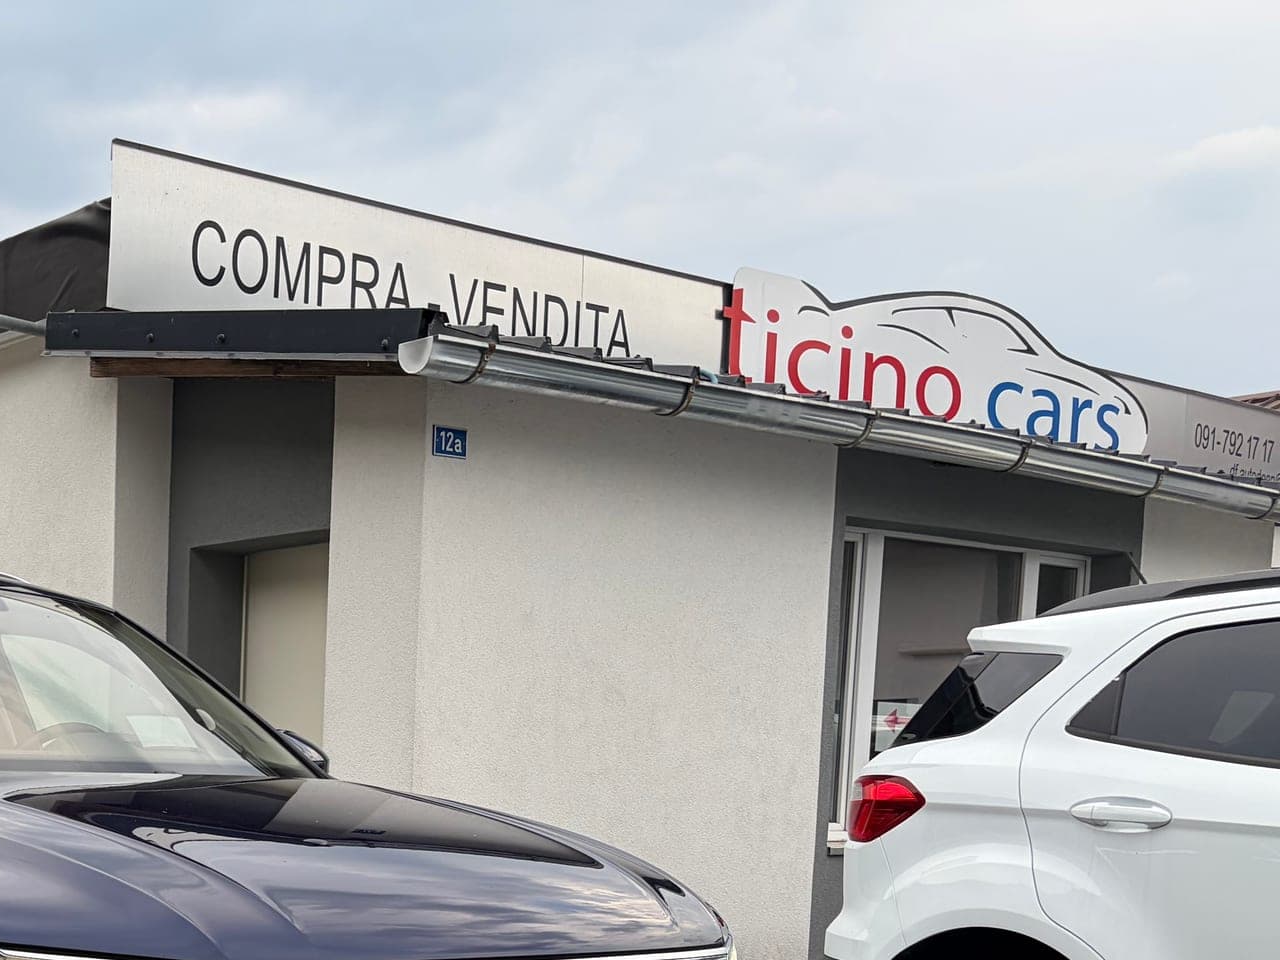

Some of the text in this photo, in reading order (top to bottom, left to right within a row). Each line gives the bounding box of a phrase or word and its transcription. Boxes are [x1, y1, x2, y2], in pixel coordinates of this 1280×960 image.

[192, 220, 410, 309] COMPRA
[449, 273, 630, 357] VENDITA
[440, 431, 463, 453] 12a
[1195, 423, 1275, 463] 091-792 17 17
